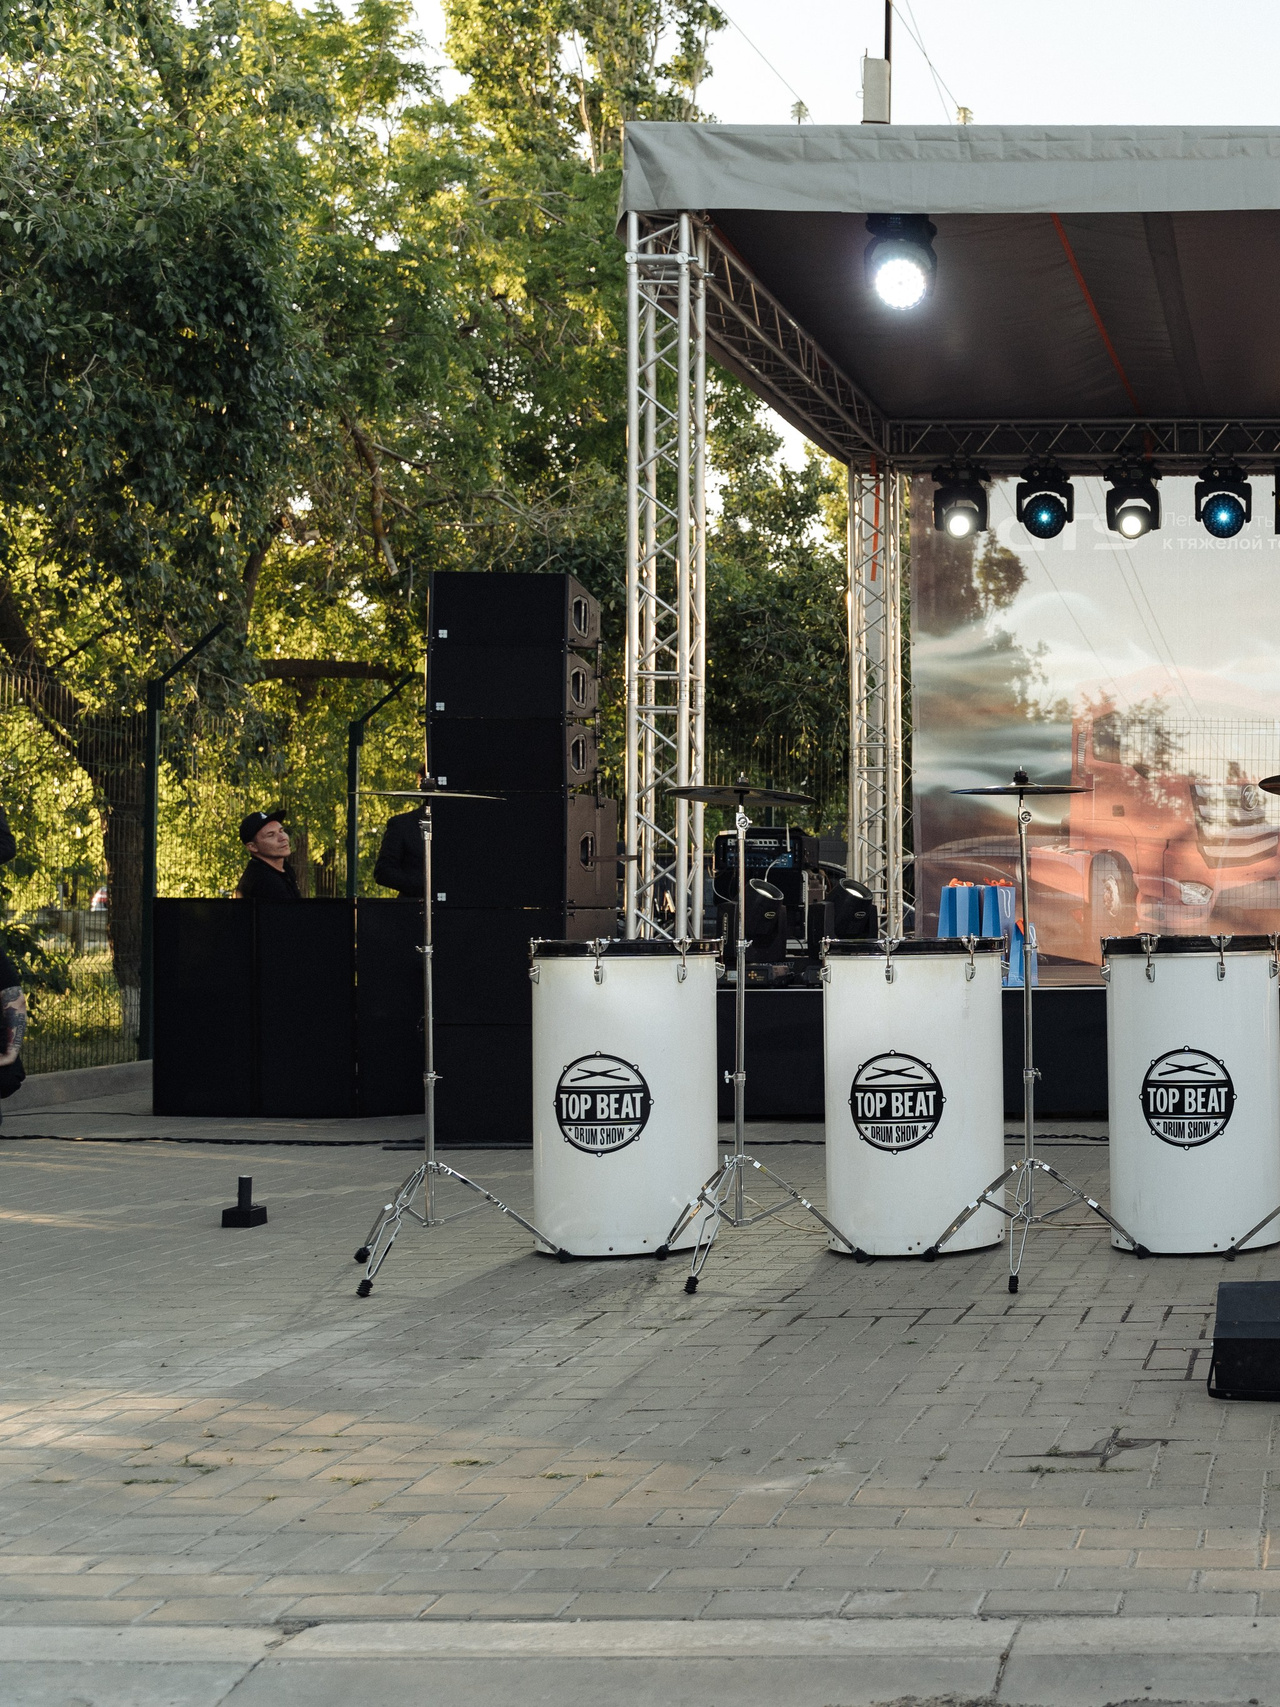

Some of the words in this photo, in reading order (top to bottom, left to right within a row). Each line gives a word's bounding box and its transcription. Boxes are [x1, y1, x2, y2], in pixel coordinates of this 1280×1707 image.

[1177, 535, 1263, 550] тяжелой
[560, 1093, 592, 1120] TOP
[596, 1092, 644, 1119] BEAT
[855, 1092, 887, 1118] TOP
[891, 1090, 937, 1117] BEAT
[1147, 1087, 1180, 1113] TOP
[1184, 1087, 1228, 1113] BEAT
[574, 1126, 598, 1145] DRUM
[600, 1127, 625, 1145] SHOW
[871, 1126, 893, 1143] DRUM
[895, 1125, 919, 1143] SHOW
[1163, 1121, 1185, 1139] DRUM
[1187, 1121, 1211, 1139] SHOW
